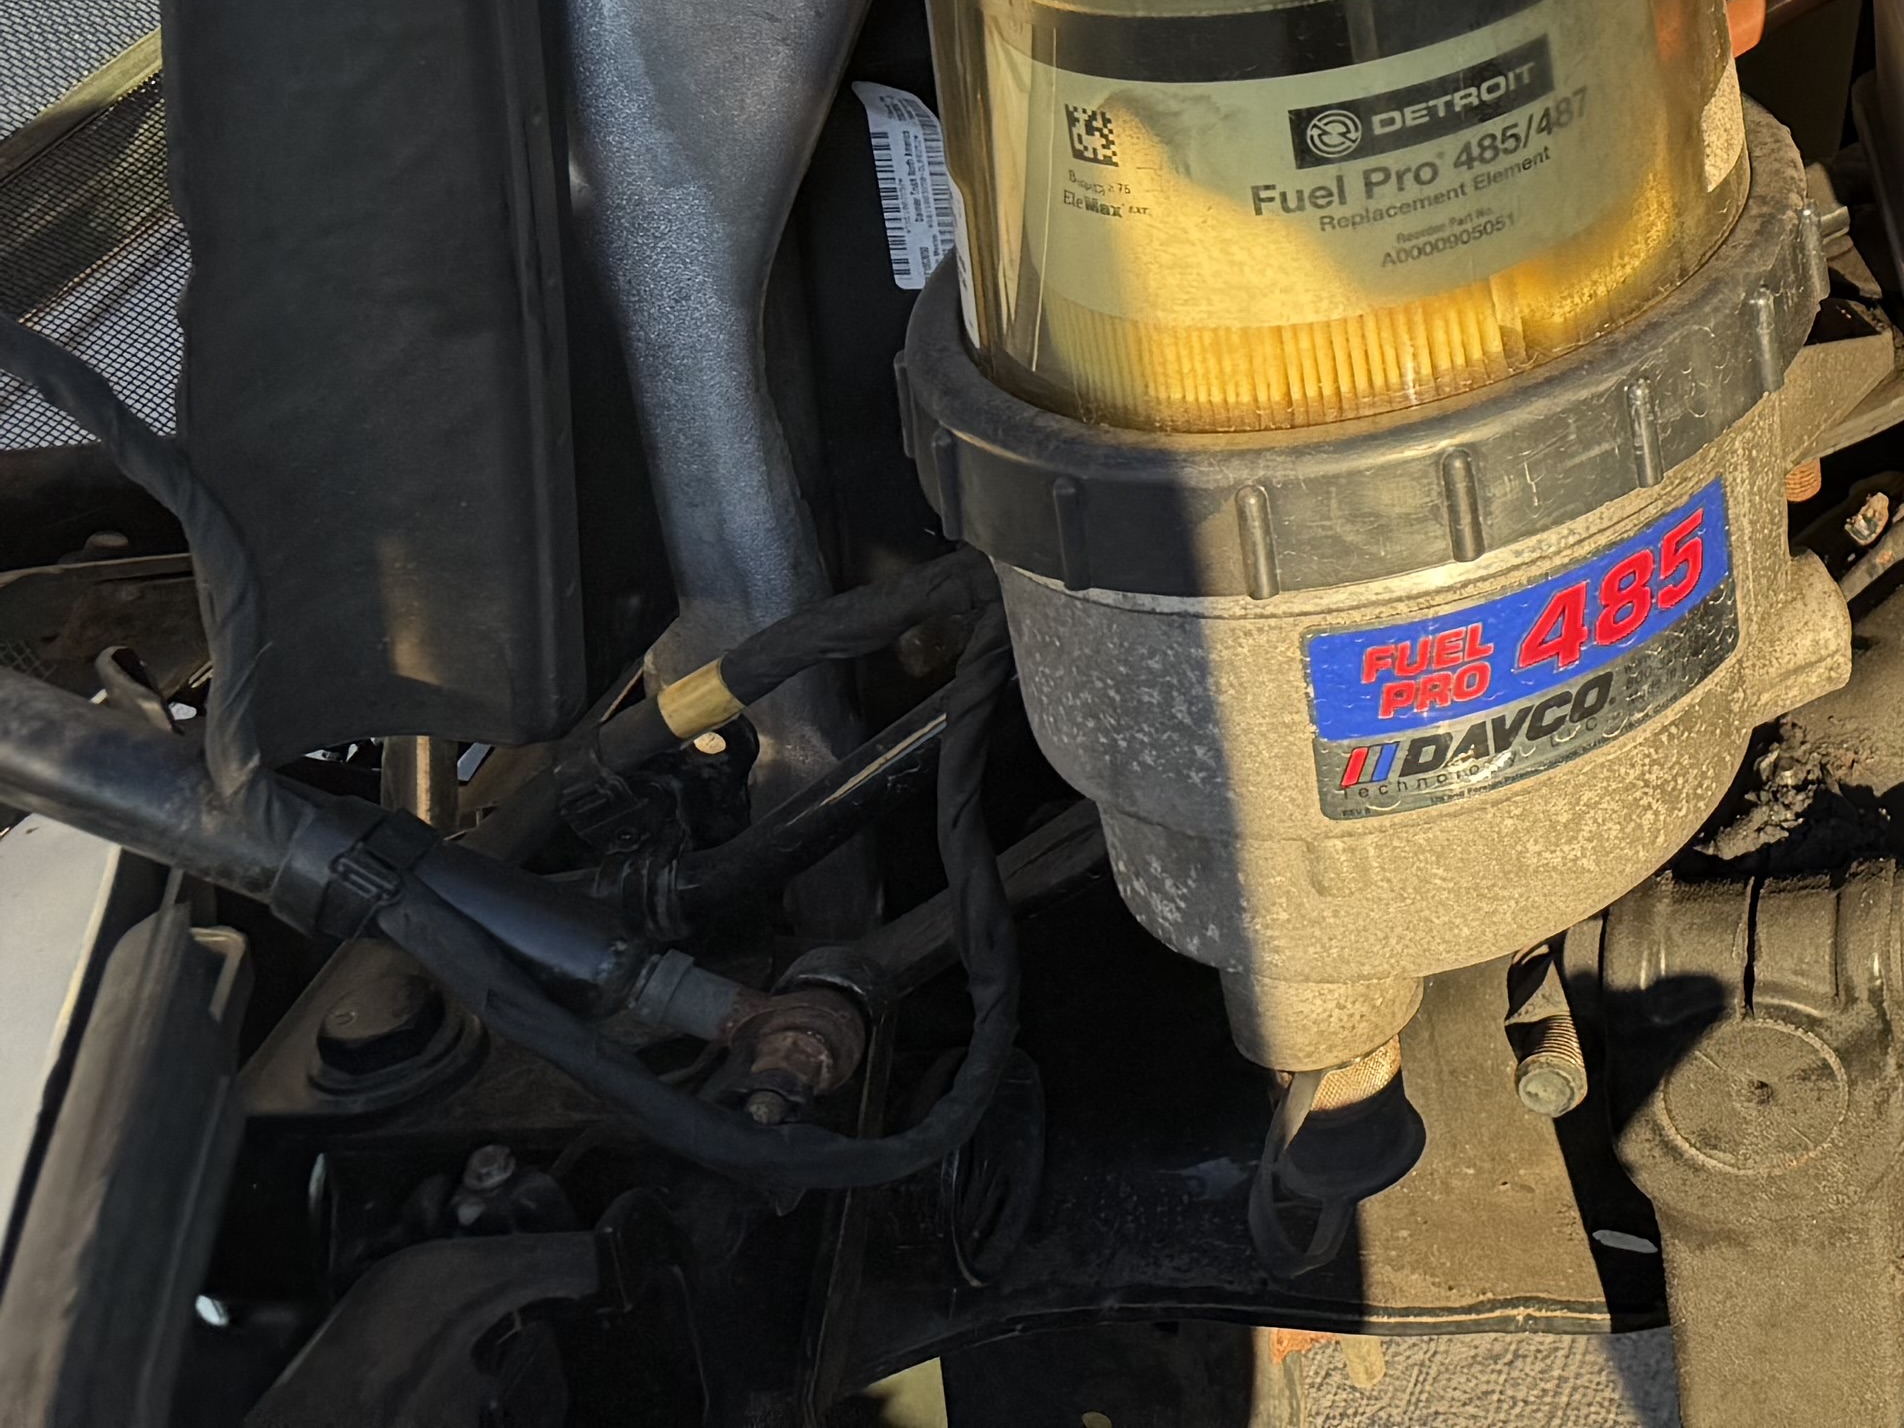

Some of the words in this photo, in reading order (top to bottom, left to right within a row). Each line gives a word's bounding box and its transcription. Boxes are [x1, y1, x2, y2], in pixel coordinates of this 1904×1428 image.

[1371, 61, 1537, 136] DETROIT
[1250, 174, 1348, 217] Fuel
[1363, 160, 1441, 200] Pro
[1453, 85, 1589, 172] 485/487
[1319, 184, 1468, 233] Replacement
[1473, 145, 1552, 192] Element
[1515, 506, 1704, 673] 485
[1361, 622, 1494, 685] FUEL
[1378, 660, 1493, 720] PRO
[1399, 670, 1615, 778] DAVCO
